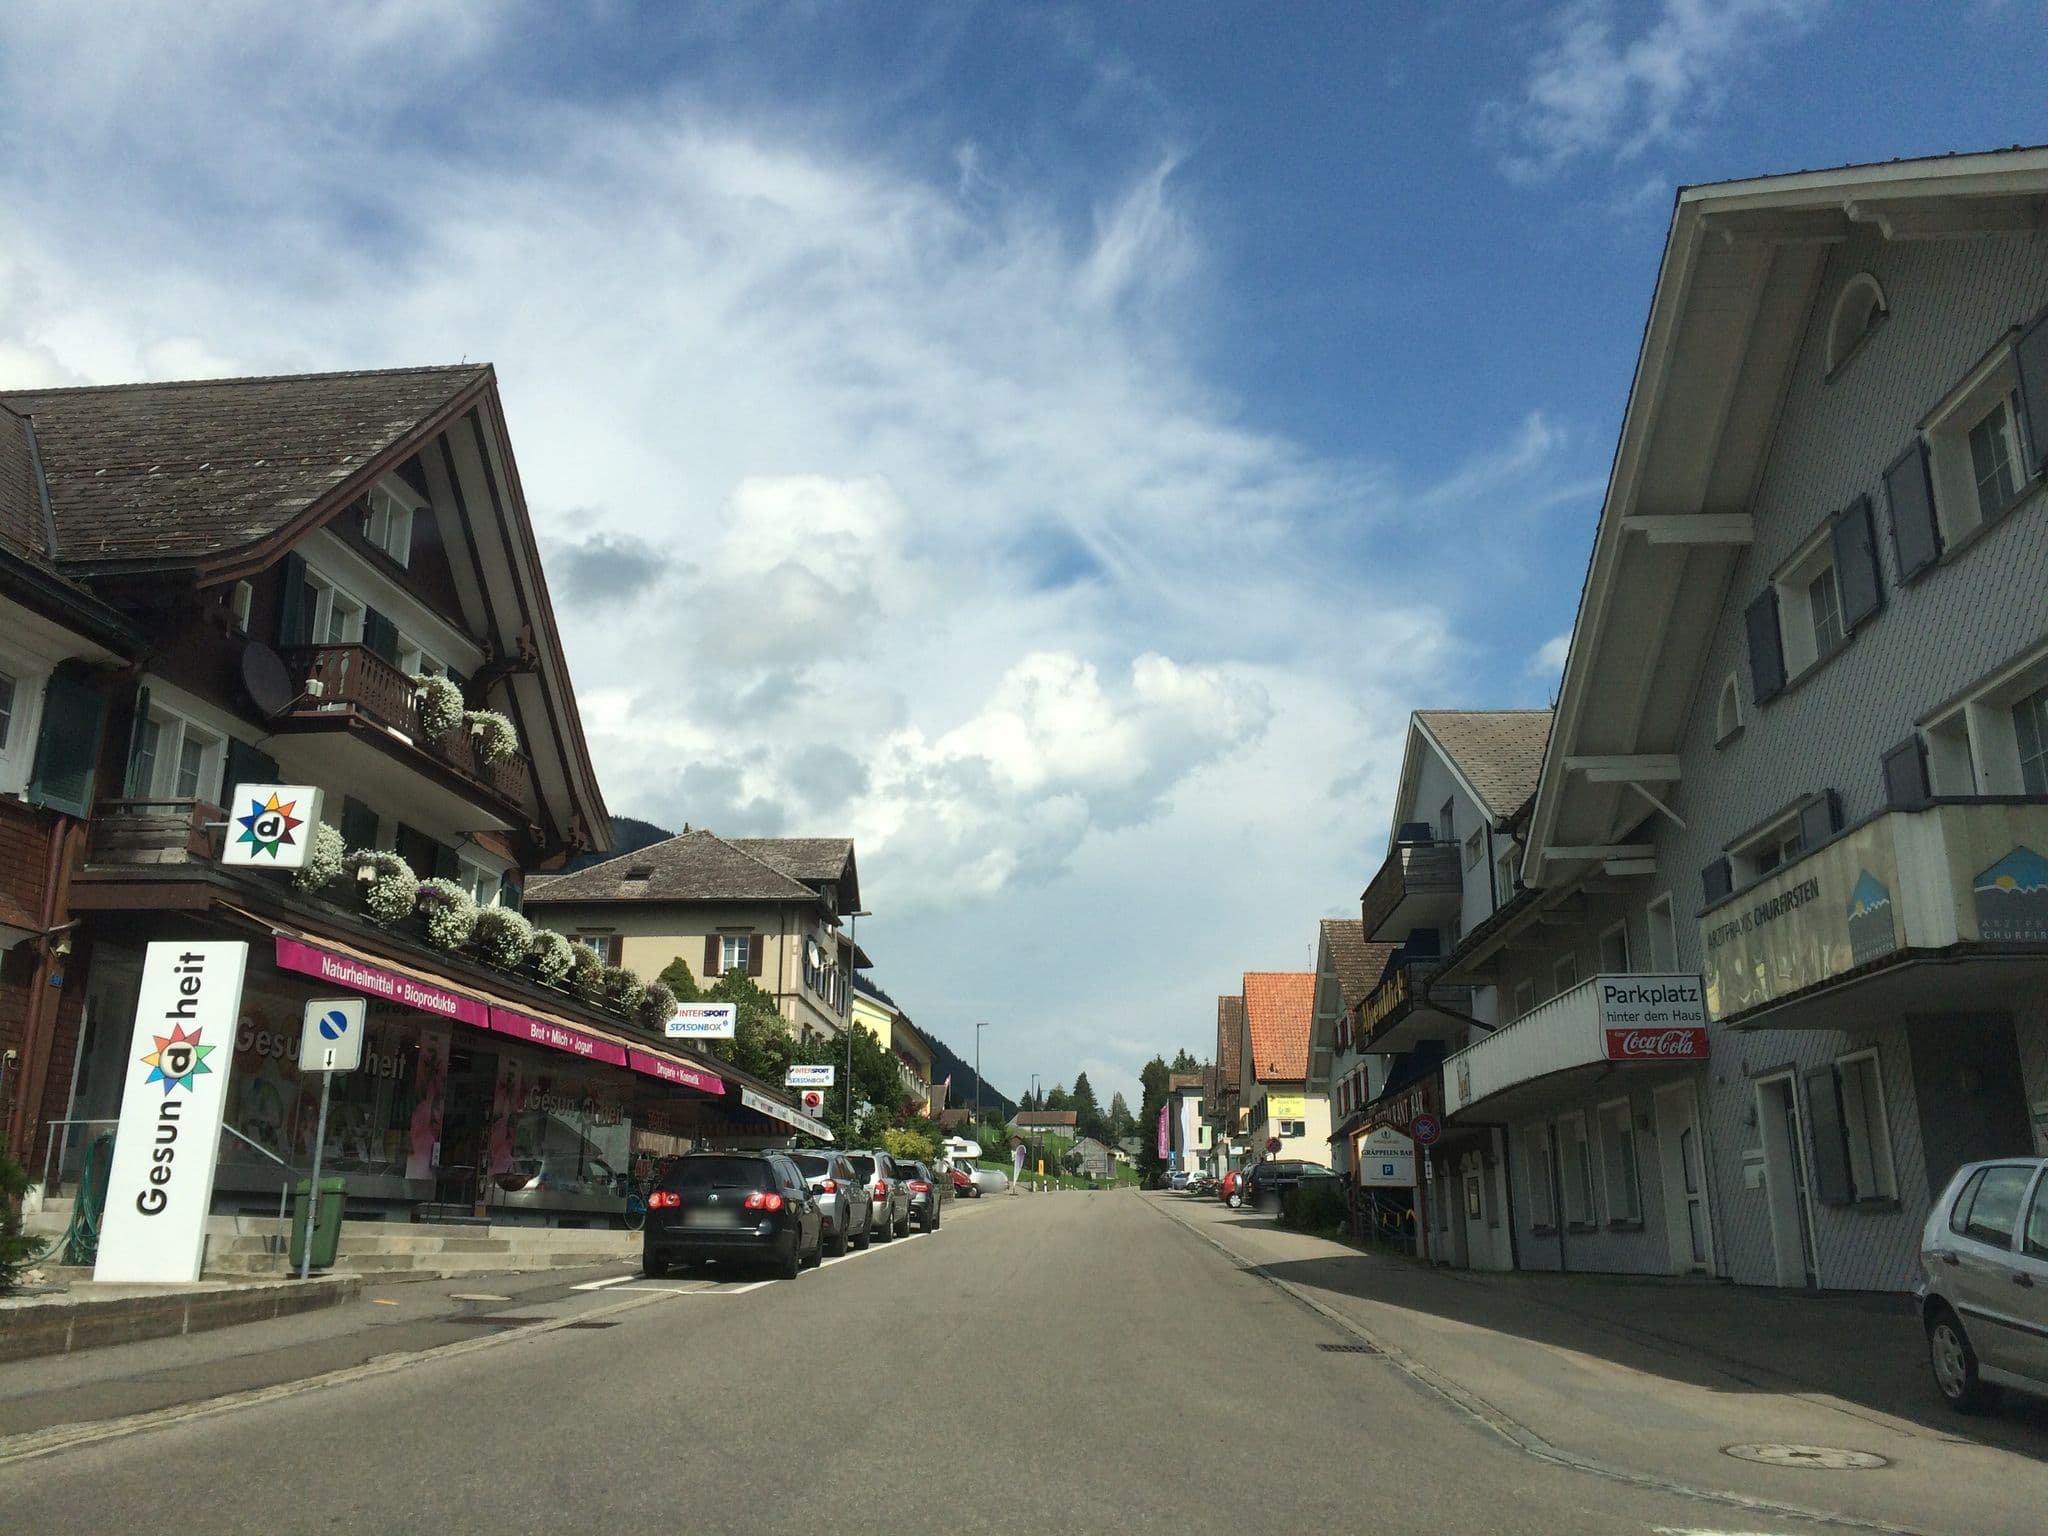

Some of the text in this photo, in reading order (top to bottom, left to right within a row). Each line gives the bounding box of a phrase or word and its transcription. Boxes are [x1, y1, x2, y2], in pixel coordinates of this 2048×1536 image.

[1753, 876, 1820, 927] CHURFIRSTEN
[321, 956, 457, 1014] Naturheilmittel Bioprodukte
[1604, 984, 1698, 1006] Parkplatz
[679, 1009, 730, 1018] INTERSPORT
[1606, 1010, 1702, 1022] hinter dem Haus
[669, 1023, 722, 1031] SEASONBOX
[530, 1023, 592, 1055] Brot Milch Jogurt
[1622, 1030, 1696, 1055] Coca-Cola
[793, 1067, 830, 1075] INTERSPORT
